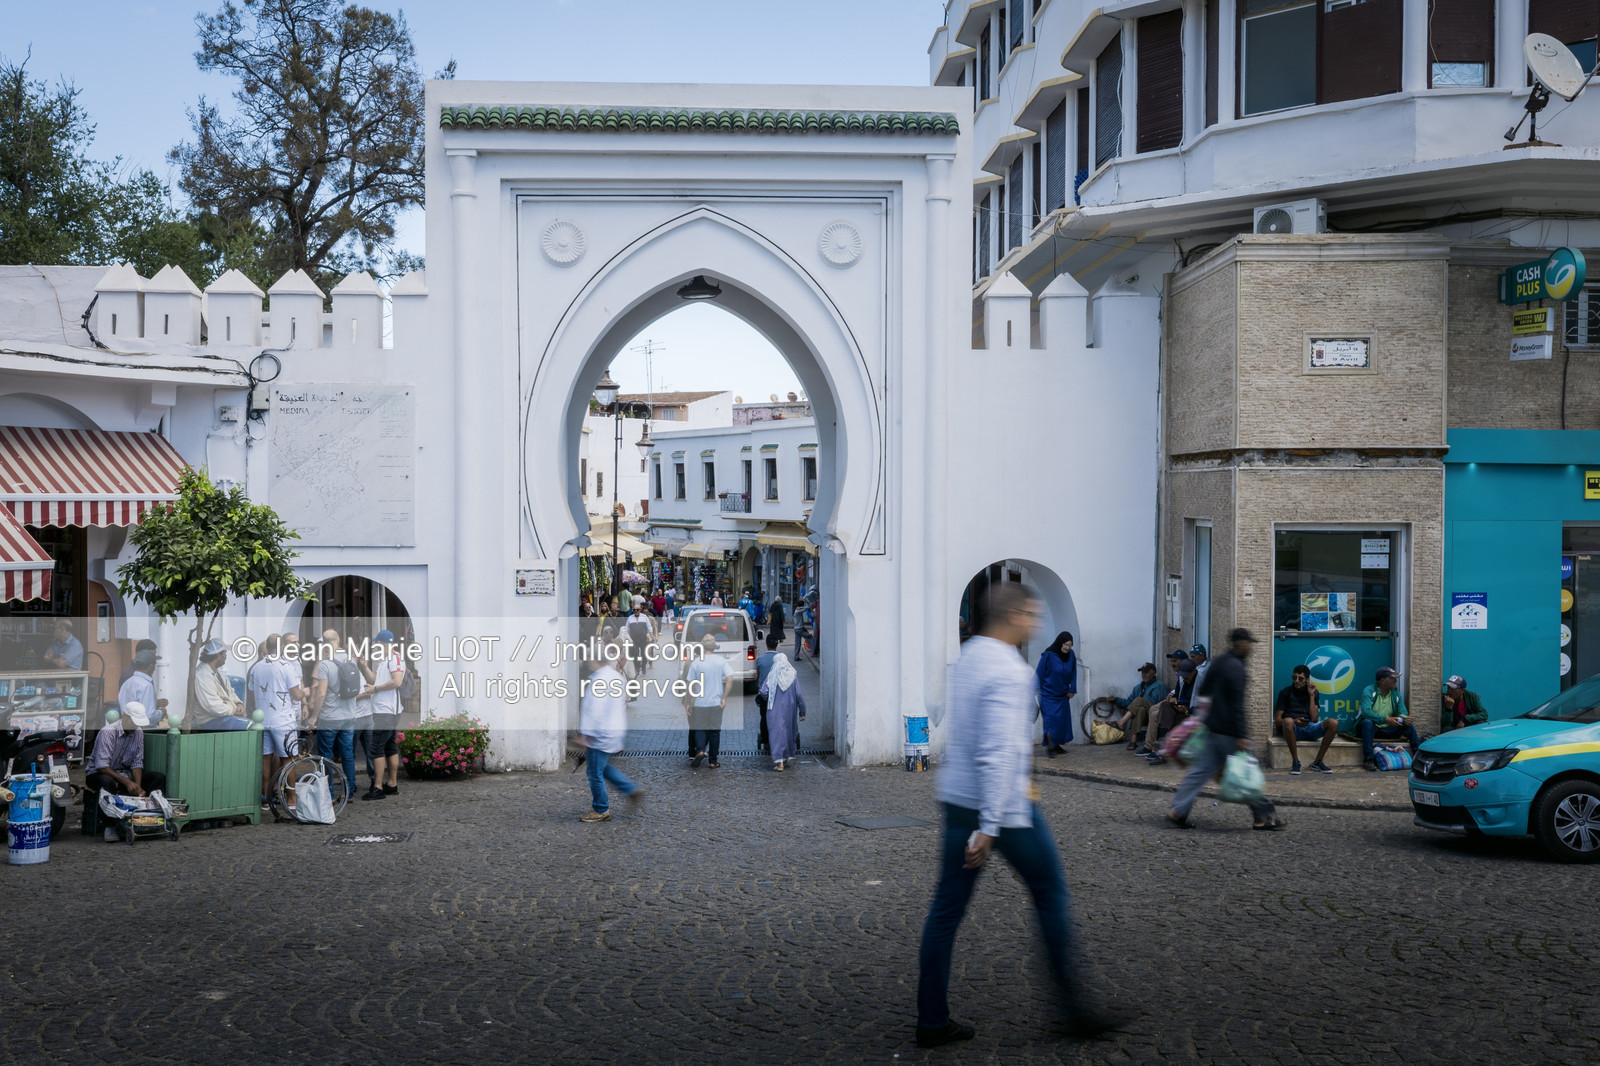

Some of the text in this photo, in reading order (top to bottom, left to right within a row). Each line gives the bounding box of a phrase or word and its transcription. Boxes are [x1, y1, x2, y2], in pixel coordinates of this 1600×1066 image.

[1516, 265, 1540, 283] CASH
[1516, 280, 1540, 298] PLUS
[1534, 313, 1545, 323] WU
[279, 393, 308, 404] العتيقة
